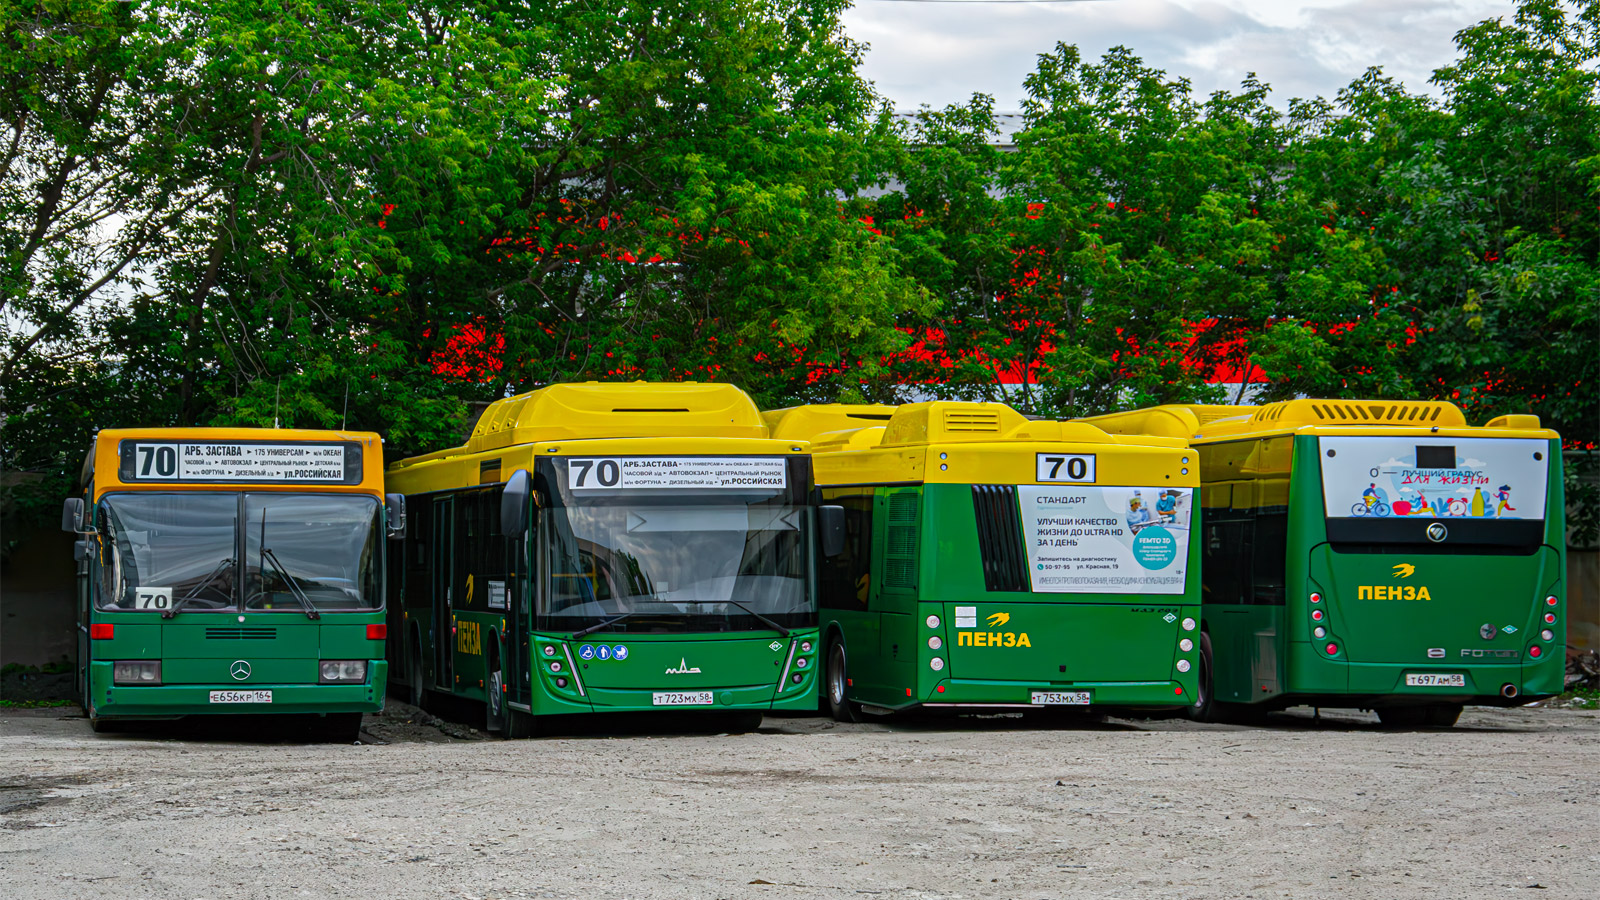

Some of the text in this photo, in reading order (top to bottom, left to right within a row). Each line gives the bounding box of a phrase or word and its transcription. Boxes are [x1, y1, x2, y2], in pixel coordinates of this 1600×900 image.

[185, 446, 203, 456] АРБ.
[206, 446, 242, 456] ЗАСТАВА
[138, 446, 176, 476] 70
[235, 469, 266, 477] ДИЗЕЛЬНЫЙ
[284, 468, 342, 479] ул.РОССИЙСКАЯ
[570, 459, 620, 487] 70
[1045, 457, 1087, 480] 70
[1401, 469, 1484, 478] ЛУЧШИЙ ГРАДУС
[721, 477, 783, 487] ул.РОССИЙСКАЯ
[1401, 475, 1490, 485] ДЛЯ ЖИЗНИ
[1036, 496, 1087, 504] СТАНДАРТ
[1037, 518, 1118, 526] УЛУЧШИ КАЧЕСТВО
[1037, 528, 1124, 537] ЖИЗНИ ДО ULTRA HD
[1037, 539, 1049, 547] ЗА
[1050, 539, 1055, 547] 1
[1358, 585, 1432, 601] ПЕНЗА
[140, 594, 168, 609] 70
[457, 620, 482, 656] ПЕНЗА
[958, 631, 1032, 648] ПЕНЗА
[1451, 675, 1462, 683] 58
[699, 693, 710, 701] 58
